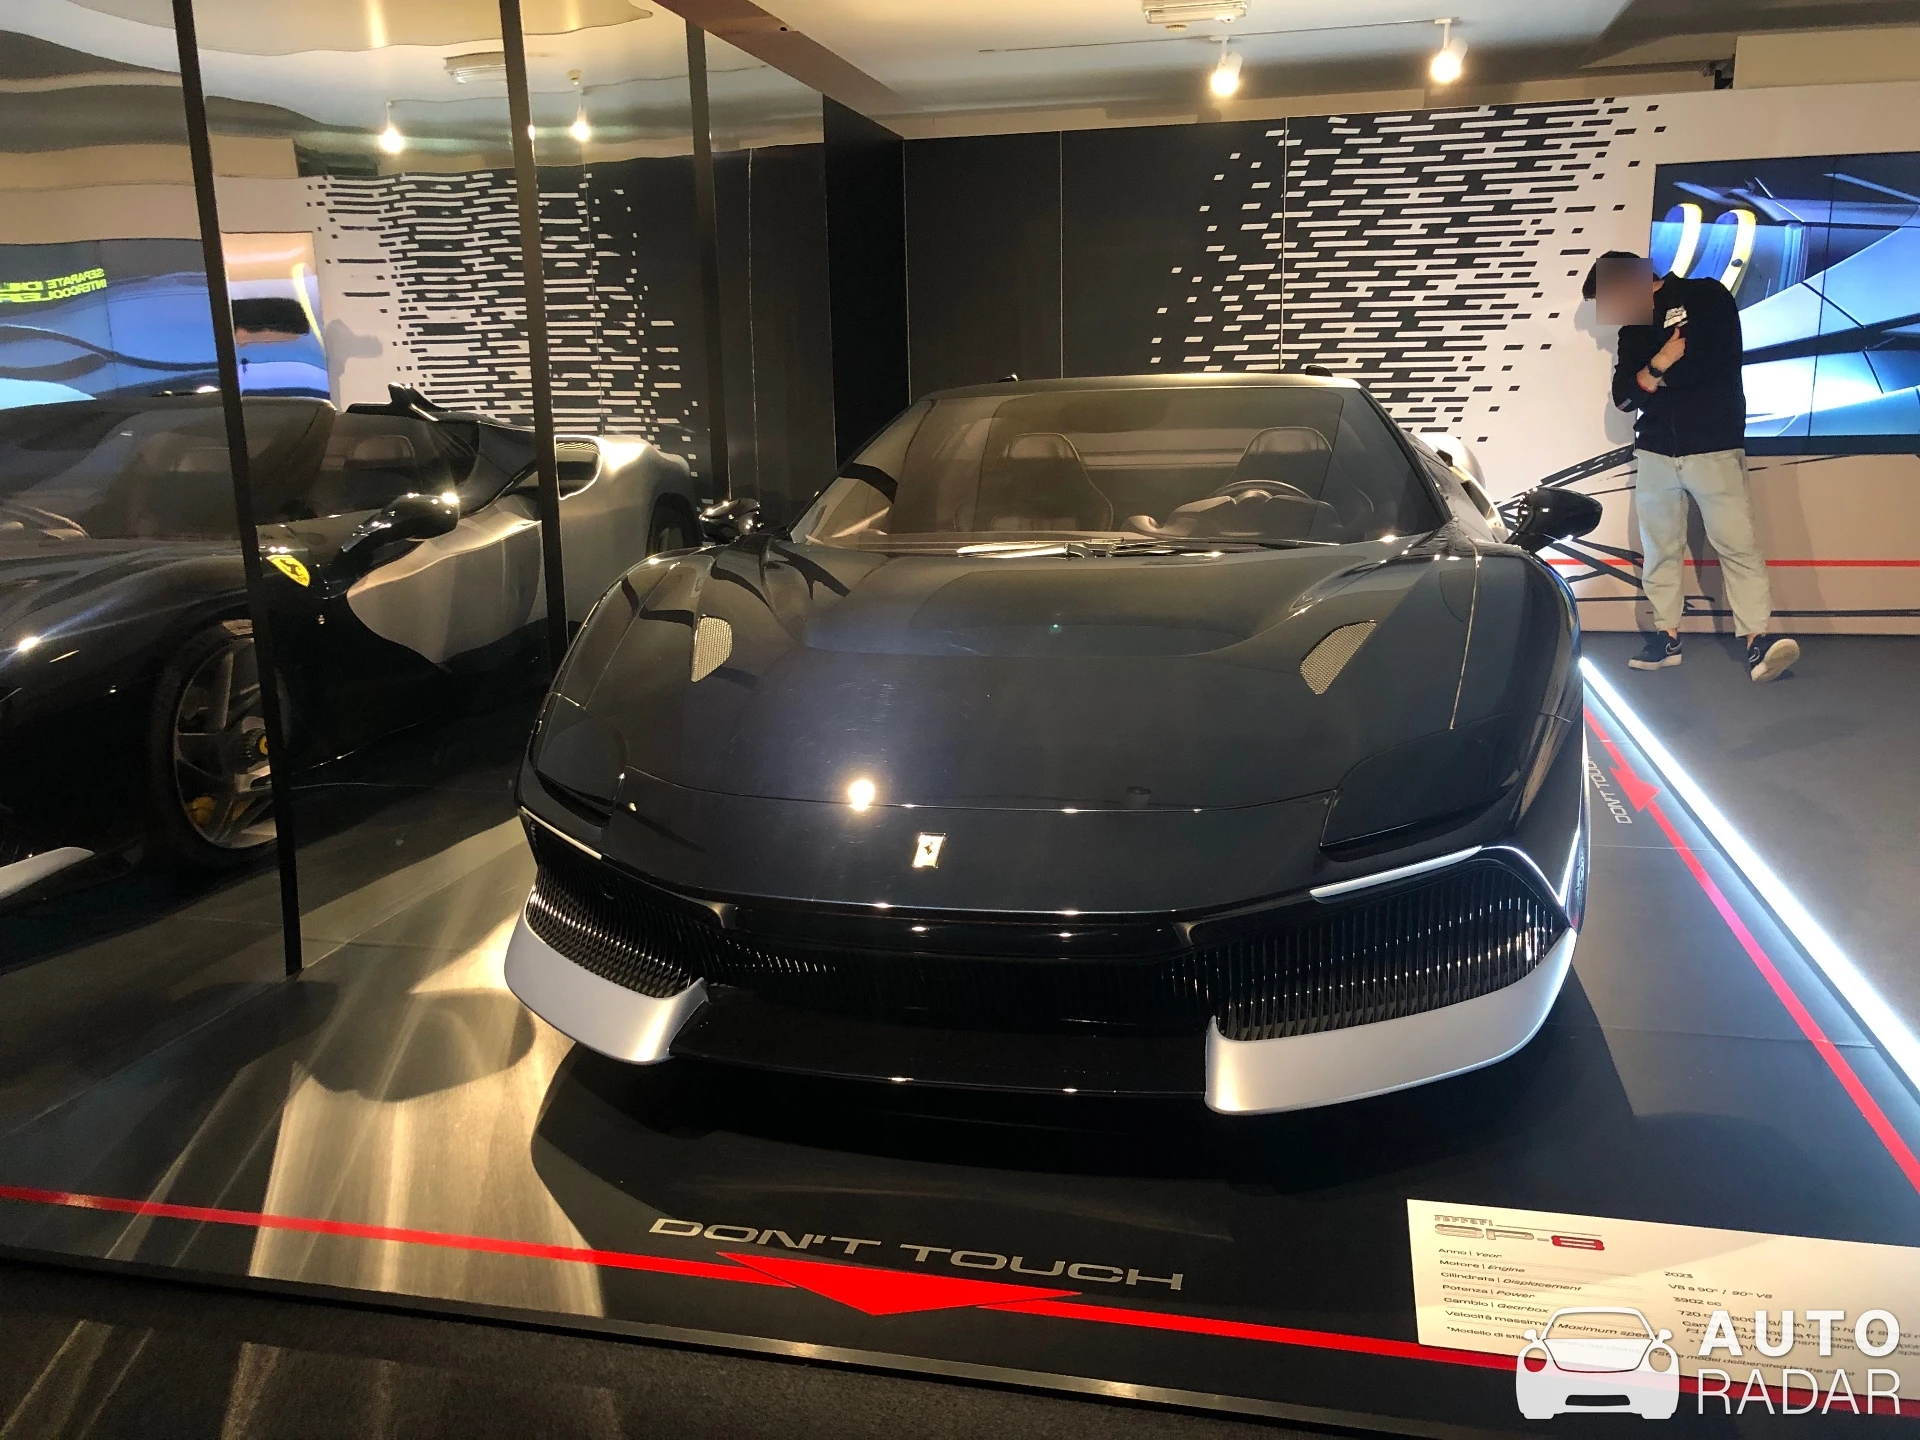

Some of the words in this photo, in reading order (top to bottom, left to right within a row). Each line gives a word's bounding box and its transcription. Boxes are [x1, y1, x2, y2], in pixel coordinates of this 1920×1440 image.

[1600, 790, 1633, 824] DON'T
[648, 1218, 881, 1253] DON'T
[899, 1243, 1183, 1291] TOUCH
[1438, 1248, 1467, 1256] Anno
[1439, 1259, 1480, 1270] Motore
[1487, 1265, 1526, 1273] Engine
[1440, 1271, 1495, 1282] Cilindrata
[1503, 1278, 1582, 1291] Displacement
[1664, 1271, 1693, 1279] 2023
[1442, 1284, 1488, 1294] Potenza
[1496, 1290, 1536, 1299] Power
[1668, 1283, 1686, 1291] V8
[1444, 1297, 1489, 1307] Cambio
[1497, 1303, 1549, 1313] Gearbox
[1673, 1296, 1704, 1305] 3902
[1677, 1309, 1701, 1318] 720
[1445, 1309, 1492, 1321] Velocità
[1495, 1316, 1548, 1327] massima
[1557, 1323, 1618, 1335] Maximum
[1494, 1330, 1503, 1338] di
[1687, 1354, 1721, 1363] model
[1723, 1358, 1787, 1369] deliberated
[1804, 1366, 1823, 1374] the
